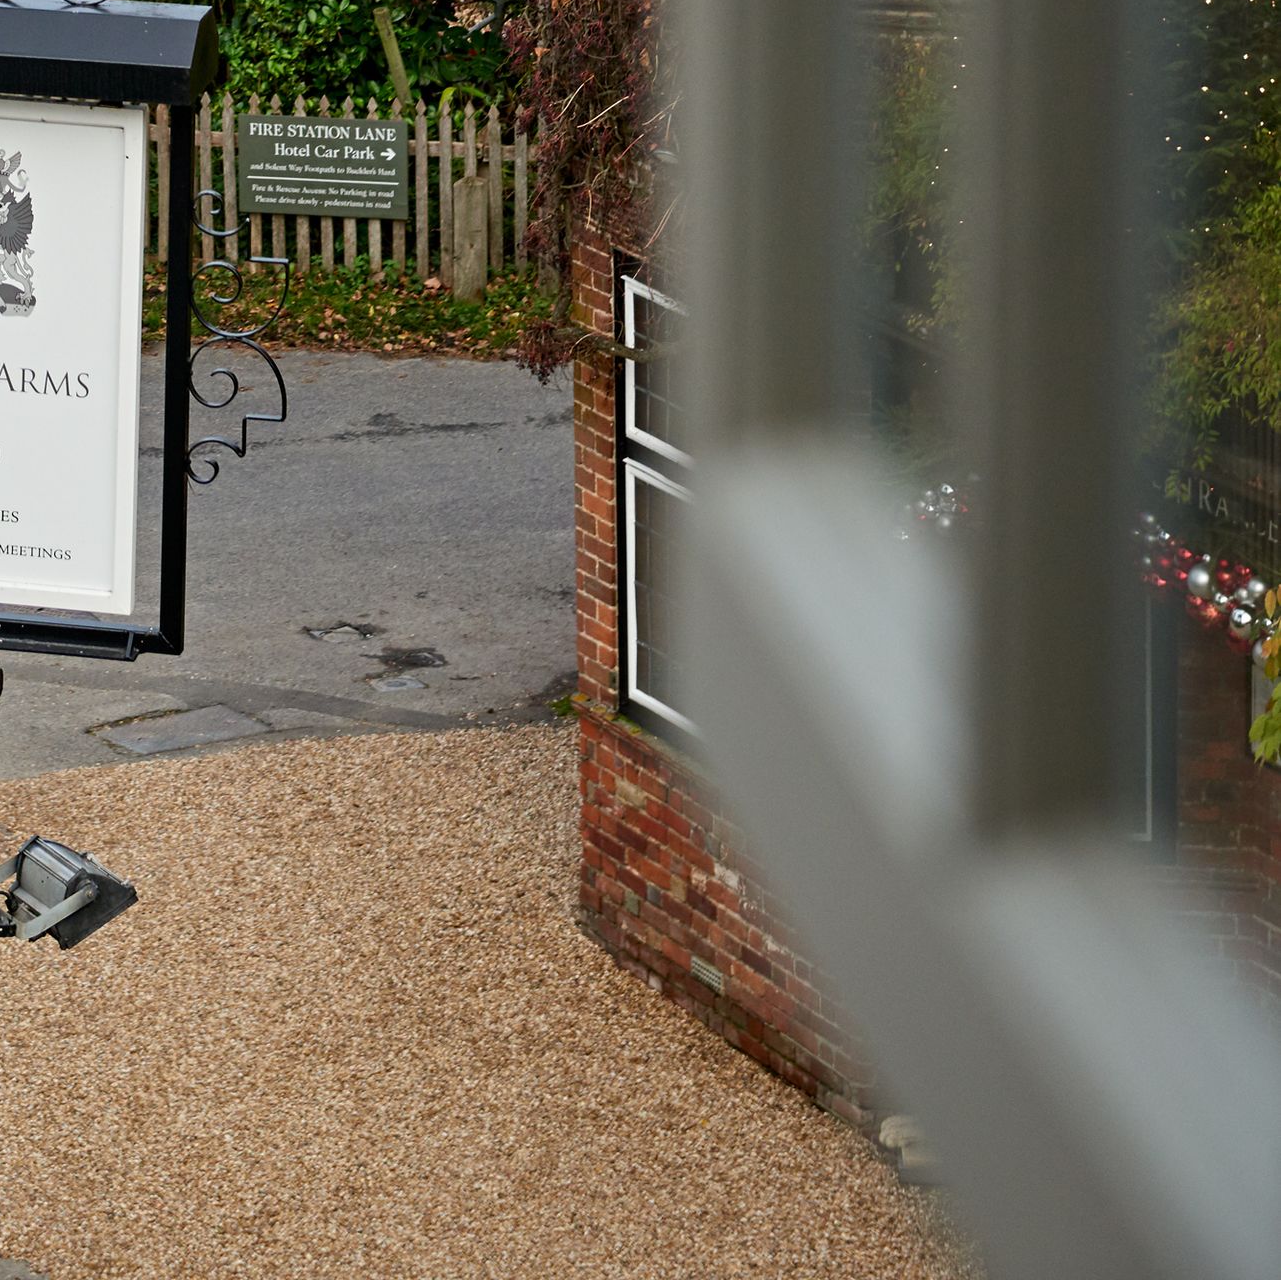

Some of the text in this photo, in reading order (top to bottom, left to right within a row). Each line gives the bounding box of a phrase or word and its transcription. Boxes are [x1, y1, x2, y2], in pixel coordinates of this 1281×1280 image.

[249, 122, 397, 142] FIRE STATION LANE
[274, 143, 376, 160] Hotel Car Park
[250, 162, 264, 170] and
[288, 163, 304, 174] Way
[304, 164, 336, 175] Footpath
[336, 166, 346, 174] to
[251, 183, 266, 192] Fire
[275, 185, 301, 194] Rescue
[328, 187, 339, 195] No
[339, 188, 368, 198] Parking
[368, 189, 377, 197] in
[255, 195, 278, 204] Please
[278, 195, 297, 204] drive
[297, 197, 319, 207] slowly
[324, 199, 365, 209] pedestrians
[365, 200, 374, 208] in
